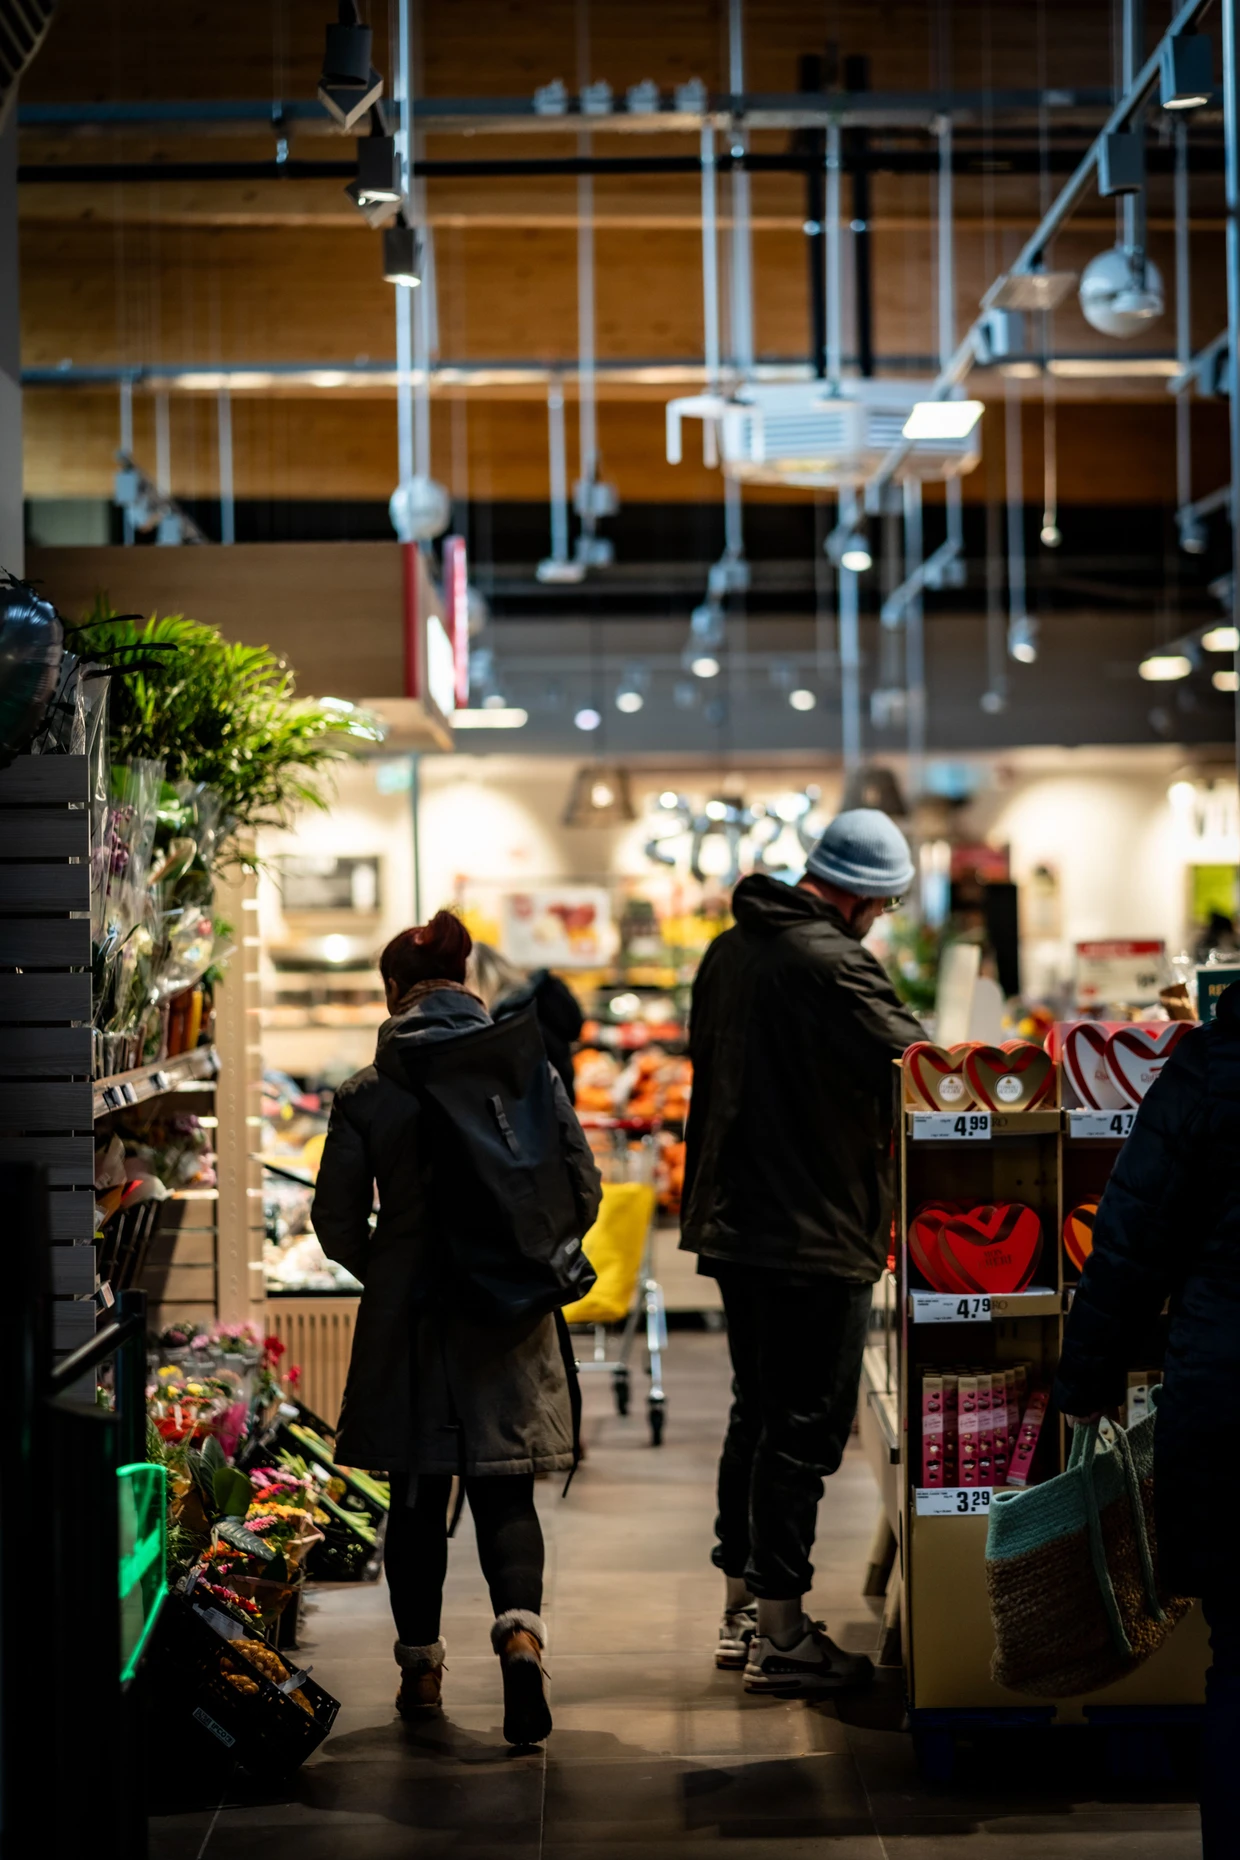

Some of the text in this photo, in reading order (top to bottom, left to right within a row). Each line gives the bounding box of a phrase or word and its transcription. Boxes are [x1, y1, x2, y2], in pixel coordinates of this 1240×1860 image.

[954, 1115, 988, 1136] 4.99
[992, 1117, 1008, 1127] RO
[1110, 1114, 1134, 1135] 4.7
[956, 1298, 991, 1319] 4.79
[992, 1300, 1008, 1310] RO
[957, 1491, 990, 1512] 3.29
[211, 1722, 228, 1737] IFCO
